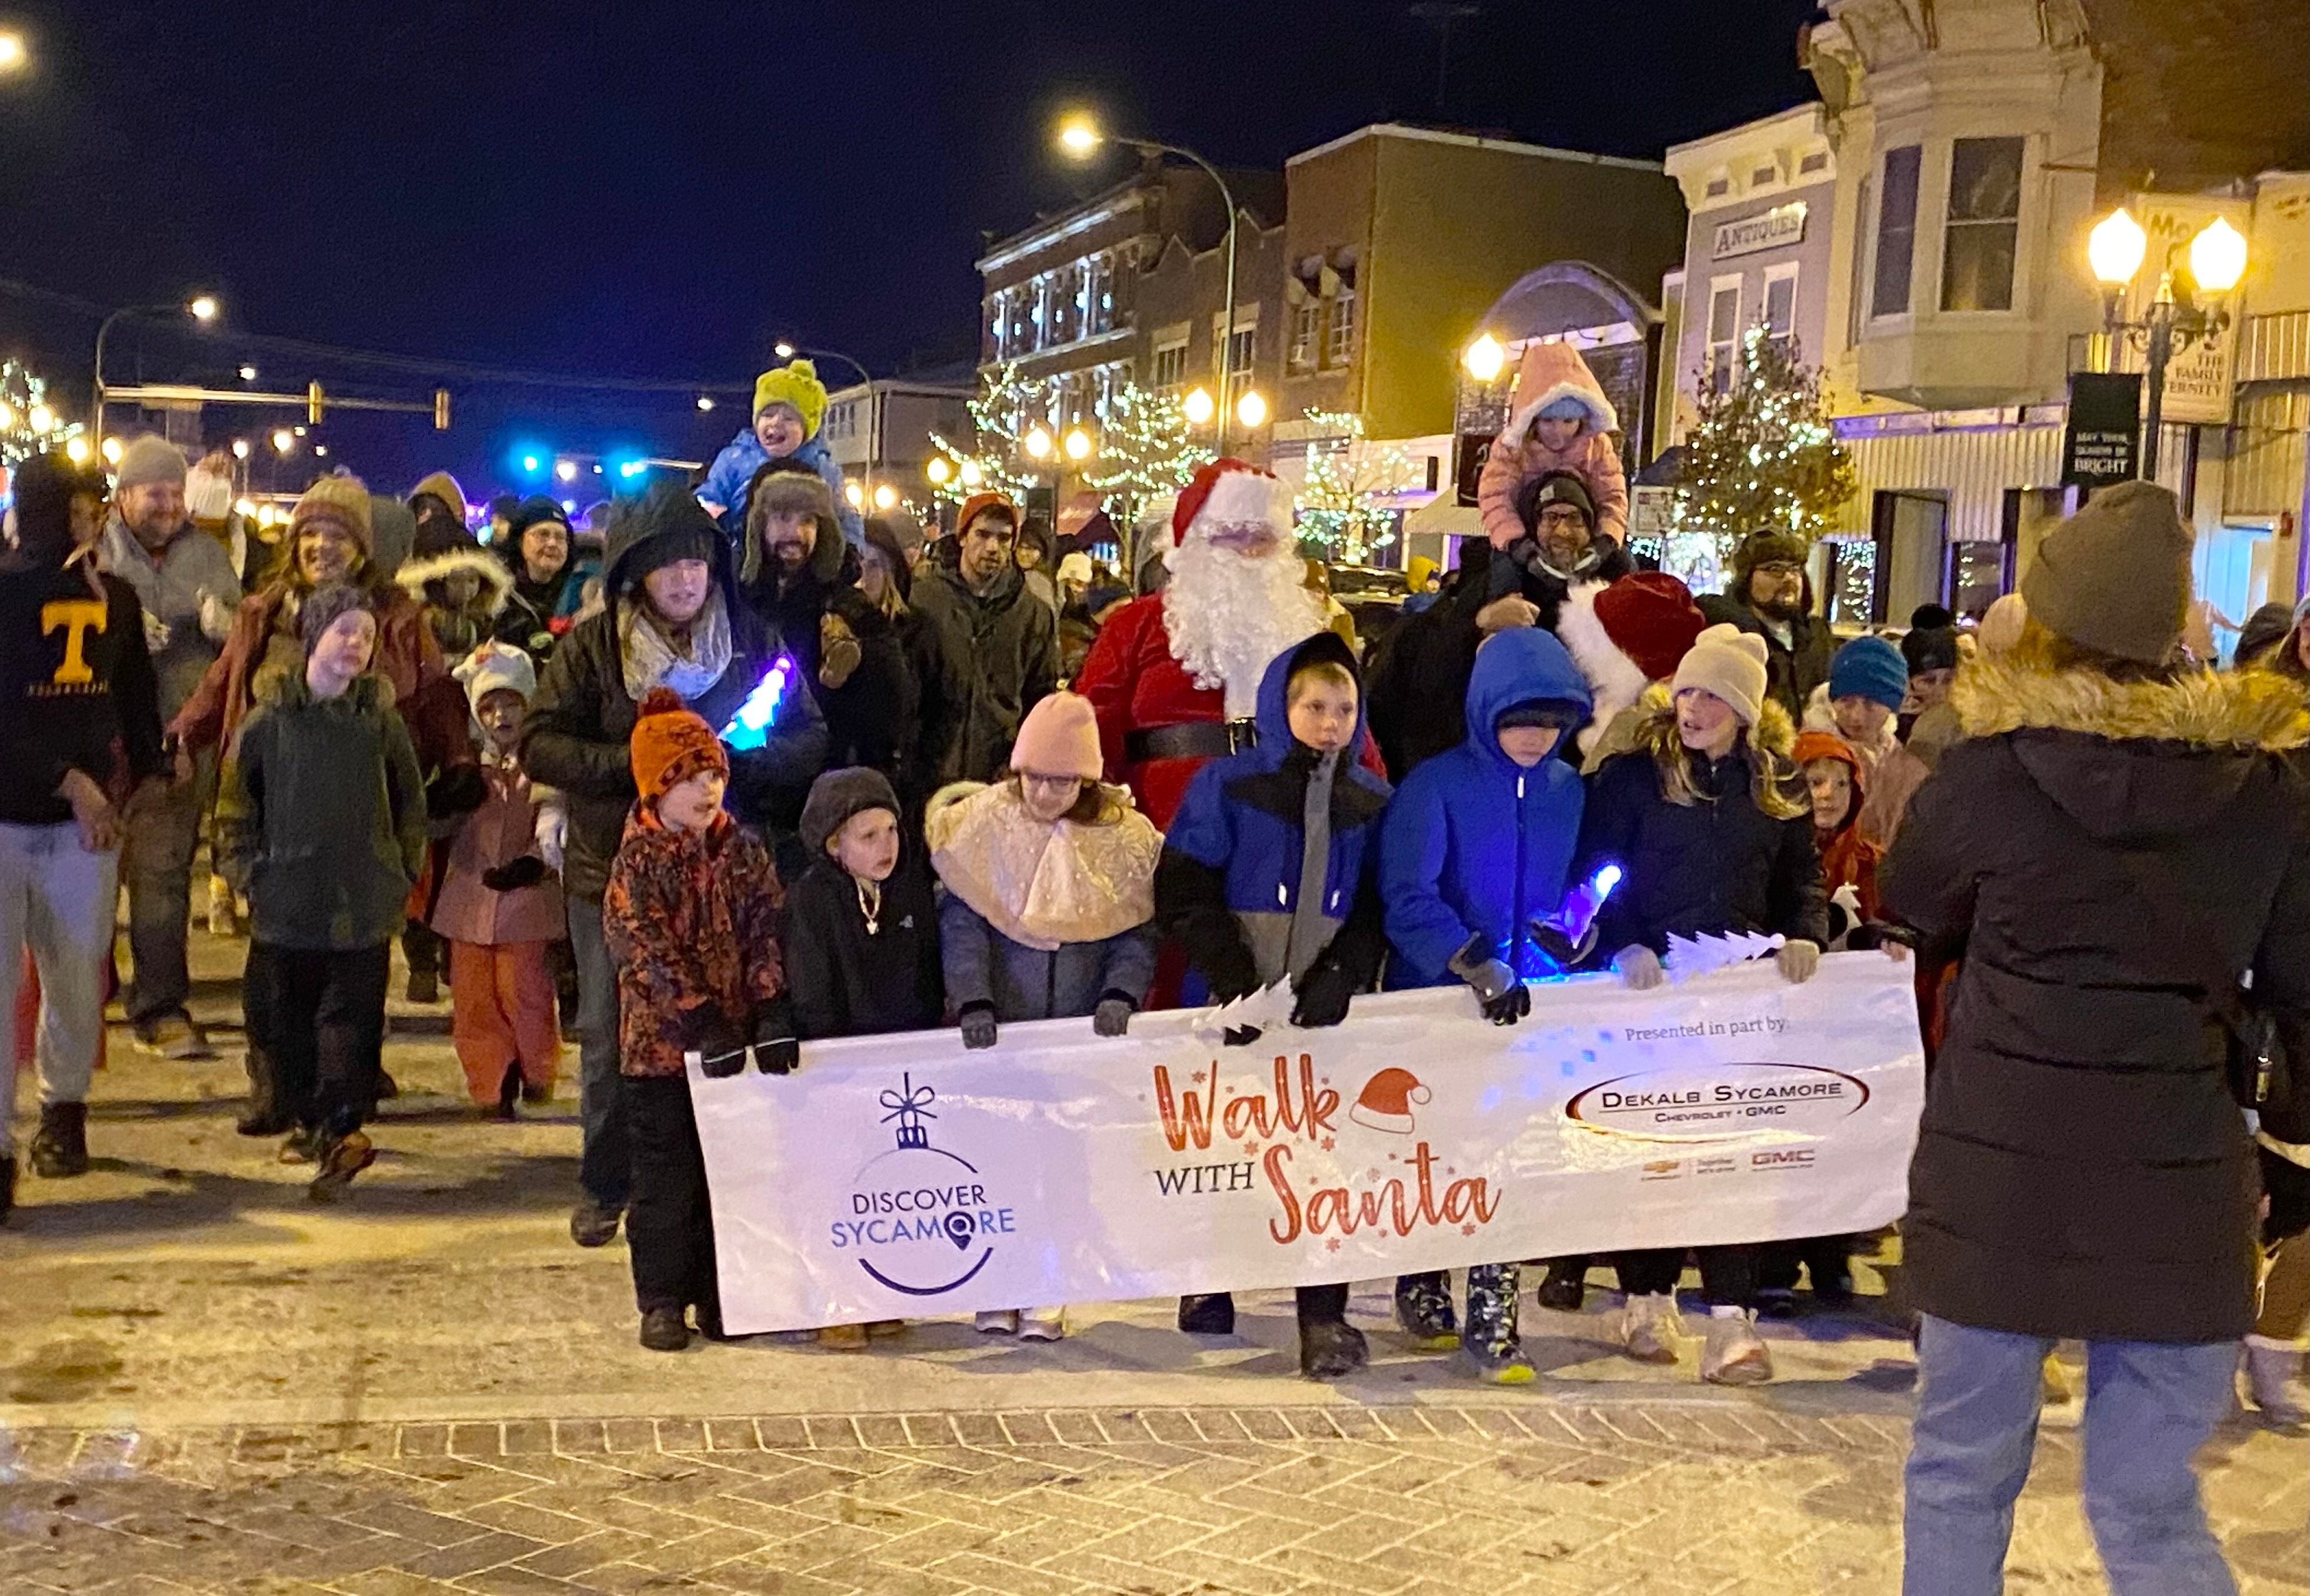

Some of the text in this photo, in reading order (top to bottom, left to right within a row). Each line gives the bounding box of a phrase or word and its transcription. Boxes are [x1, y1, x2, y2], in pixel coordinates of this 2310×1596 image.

[1717, 214, 1799, 254] ANTIQUES
[2074, 457, 2129, 476] BRIGHT
[41, 600, 107, 684] T
[1625, 1016, 1786, 1041] Presented in part by
[1154, 1053, 1340, 1152] Walk
[1602, 1082, 1843, 1108] DEKALB SYCAMORE
[1745, 1105, 1787, 1117] GMC
[1751, 1149, 1815, 1165] GMC
[852, 1184, 987, 1215] DISCOVER
[1154, 1142, 1503, 1245] WITH Santa
[831, 1208, 1016, 1251] SYCAMORE
